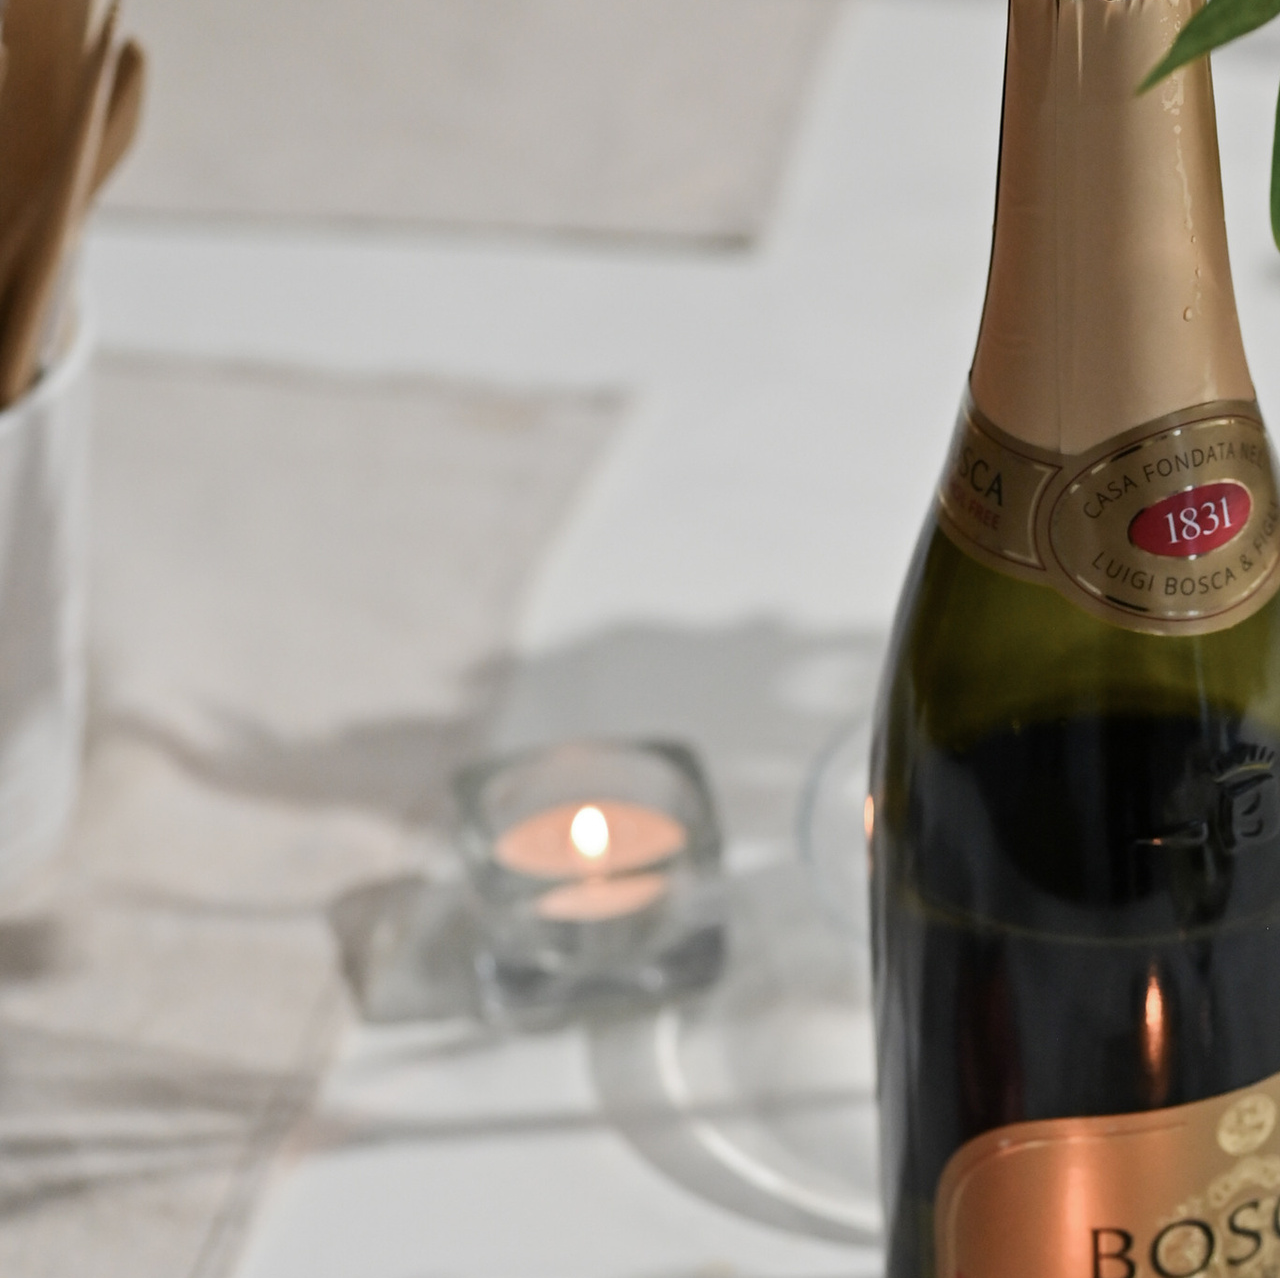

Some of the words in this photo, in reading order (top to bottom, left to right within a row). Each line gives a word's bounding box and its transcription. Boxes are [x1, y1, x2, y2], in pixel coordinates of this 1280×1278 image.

[1083, 475, 1139, 520] CASA
[1142, 443, 1238, 484] FONDATA
[1164, 496, 1234, 545] 1831
[1091, 550, 1155, 592] LUIGI
[1164, 567, 1237, 597] BOSCA
[1239, 553, 1256, 573] &
